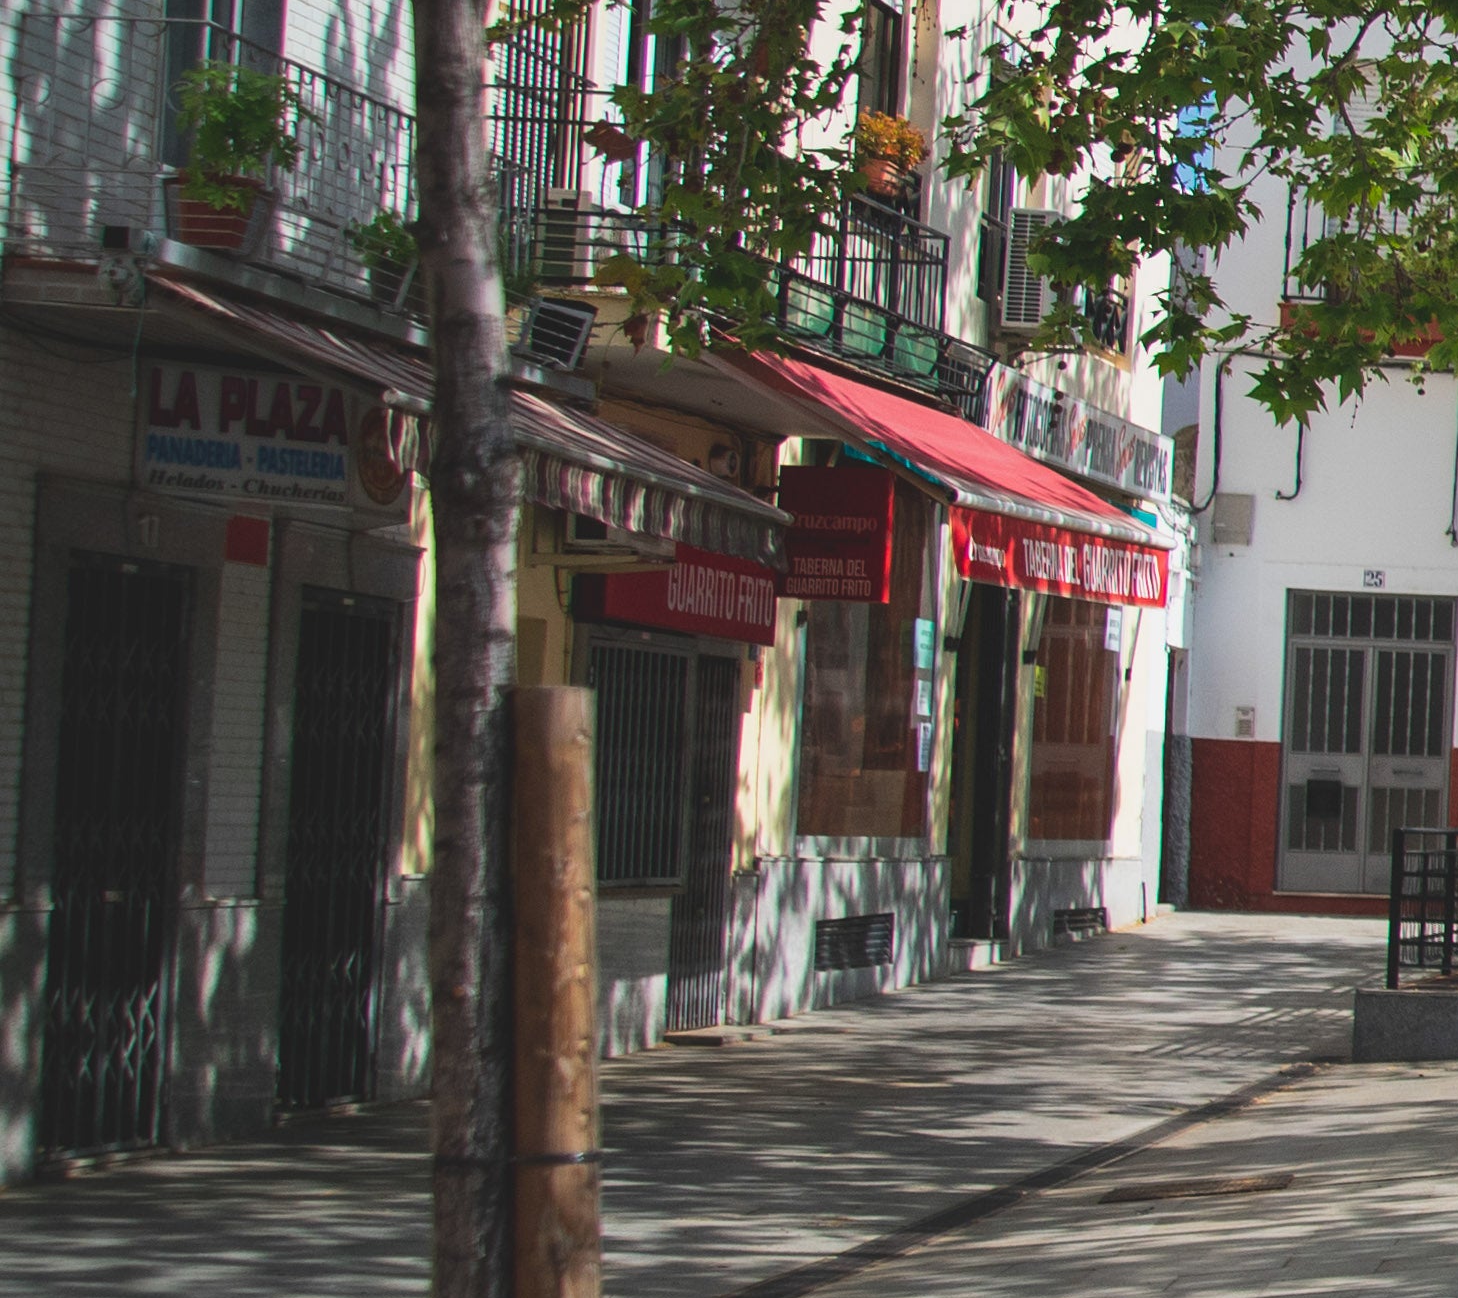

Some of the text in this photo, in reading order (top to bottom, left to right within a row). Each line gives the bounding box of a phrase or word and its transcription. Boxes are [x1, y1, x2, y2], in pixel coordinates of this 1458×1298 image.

[150, 367, 348, 445] LA PLAZA
[145, 433, 242, 470] PANADERIA
[257, 444, 346, 481] PASTELERIA
[150, 469, 224, 491] Helados
[241, 477, 346, 503] Chucherías
[786, 578, 872, 597] GUARRITO FRITO
[794, 557, 867, 577] TABERNA DEL
[1083, 544, 1131, 597] GUARRITO
[1366, 571, 1382, 587] 25
[667, 562, 774, 628] GUARRITO FRITO
